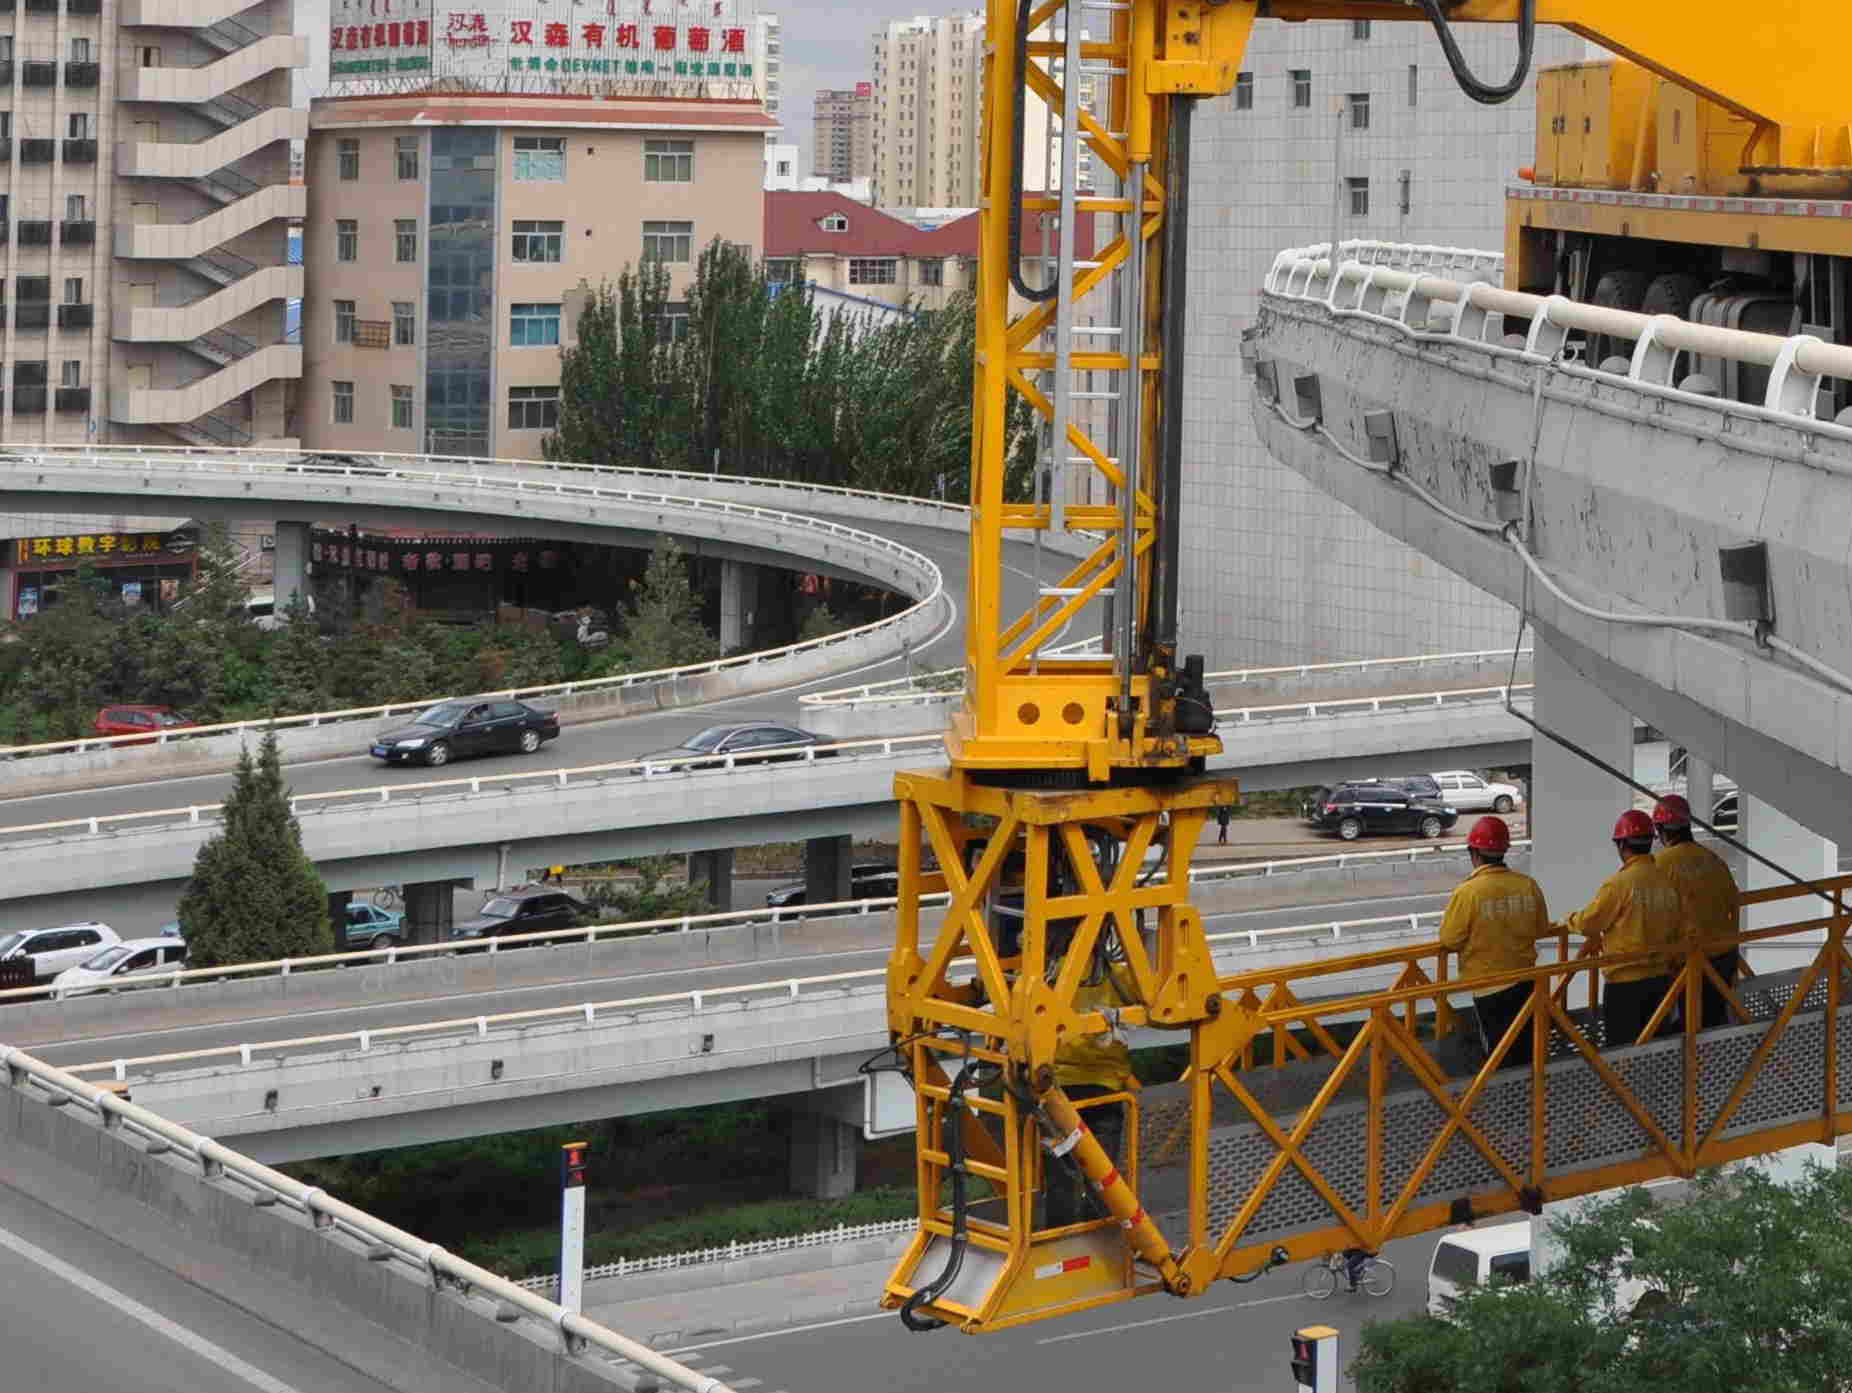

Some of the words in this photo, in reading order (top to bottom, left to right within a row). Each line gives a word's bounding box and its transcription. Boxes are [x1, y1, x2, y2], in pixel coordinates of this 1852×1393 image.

[510, 20, 746, 53] 汉森有机葡萄酒
